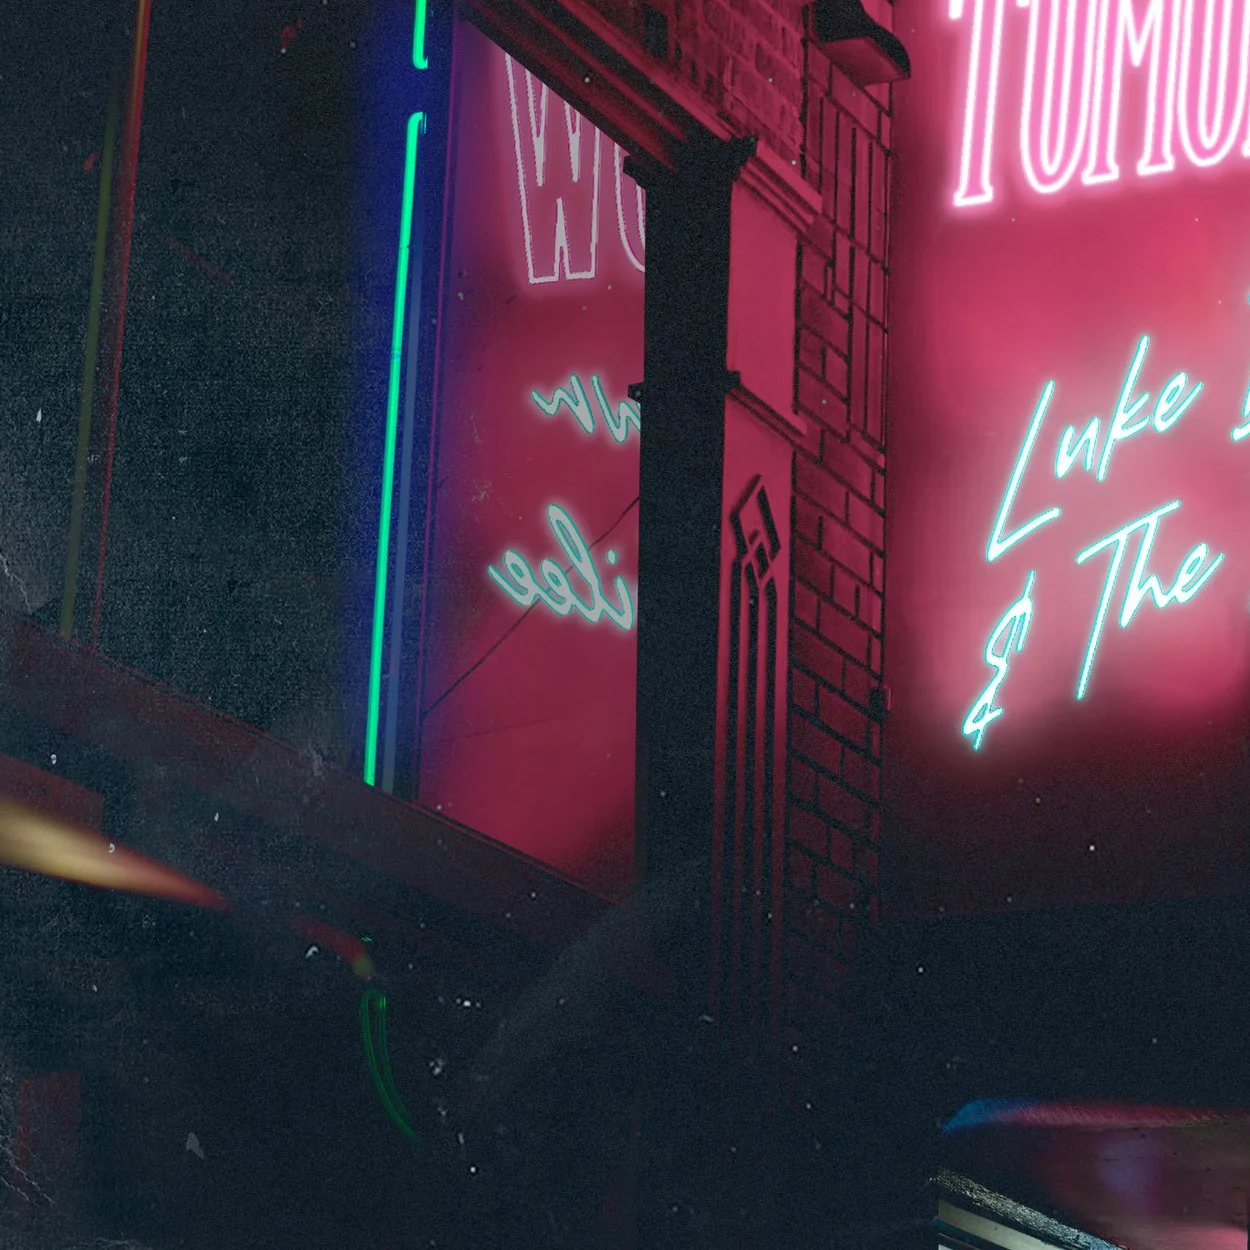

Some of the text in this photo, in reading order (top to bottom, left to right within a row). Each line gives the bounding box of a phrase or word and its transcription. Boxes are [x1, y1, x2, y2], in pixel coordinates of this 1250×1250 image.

[986, 334, 1203, 563] Luke
[962, 569, 1037, 750] &
[1074, 499, 1225, 701] The
